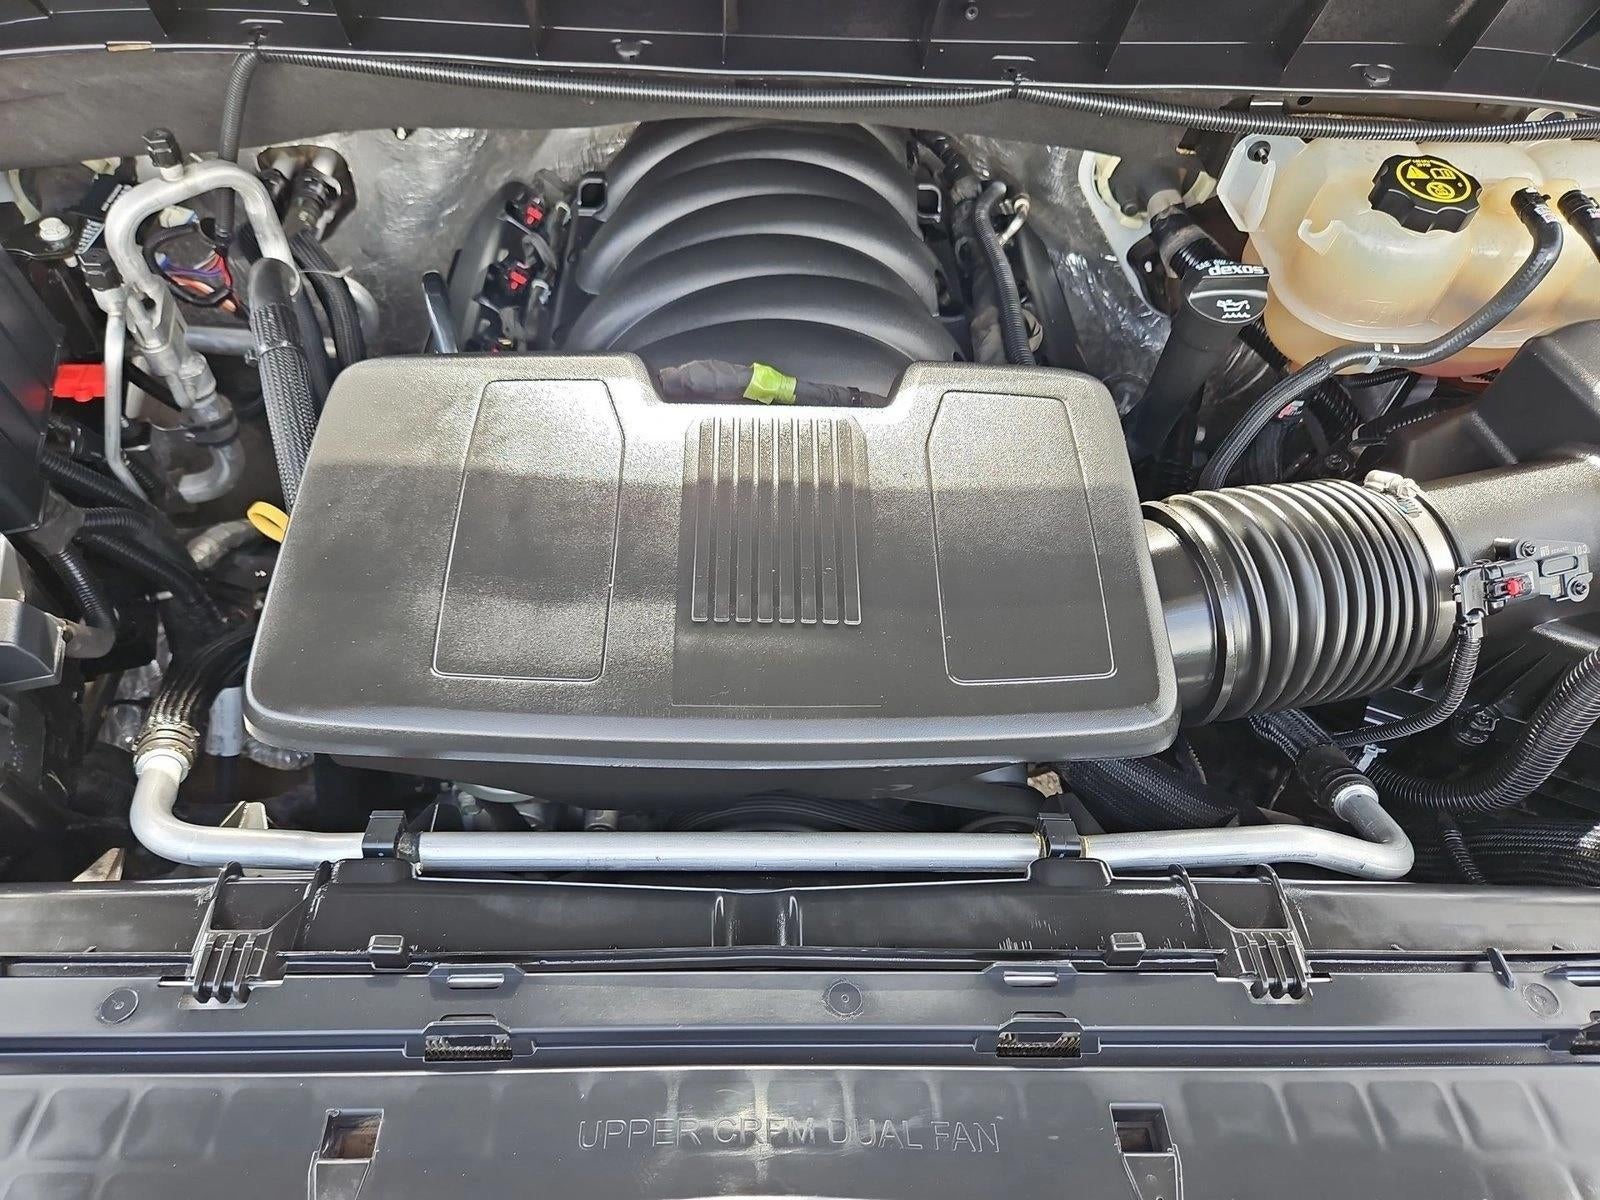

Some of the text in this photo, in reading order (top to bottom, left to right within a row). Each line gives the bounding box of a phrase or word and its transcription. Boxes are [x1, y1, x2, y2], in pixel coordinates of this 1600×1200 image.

[1208, 264, 1264, 275] dexos
[578, 1116, 1000, 1153] UPPER CRFM DUAL FAN
